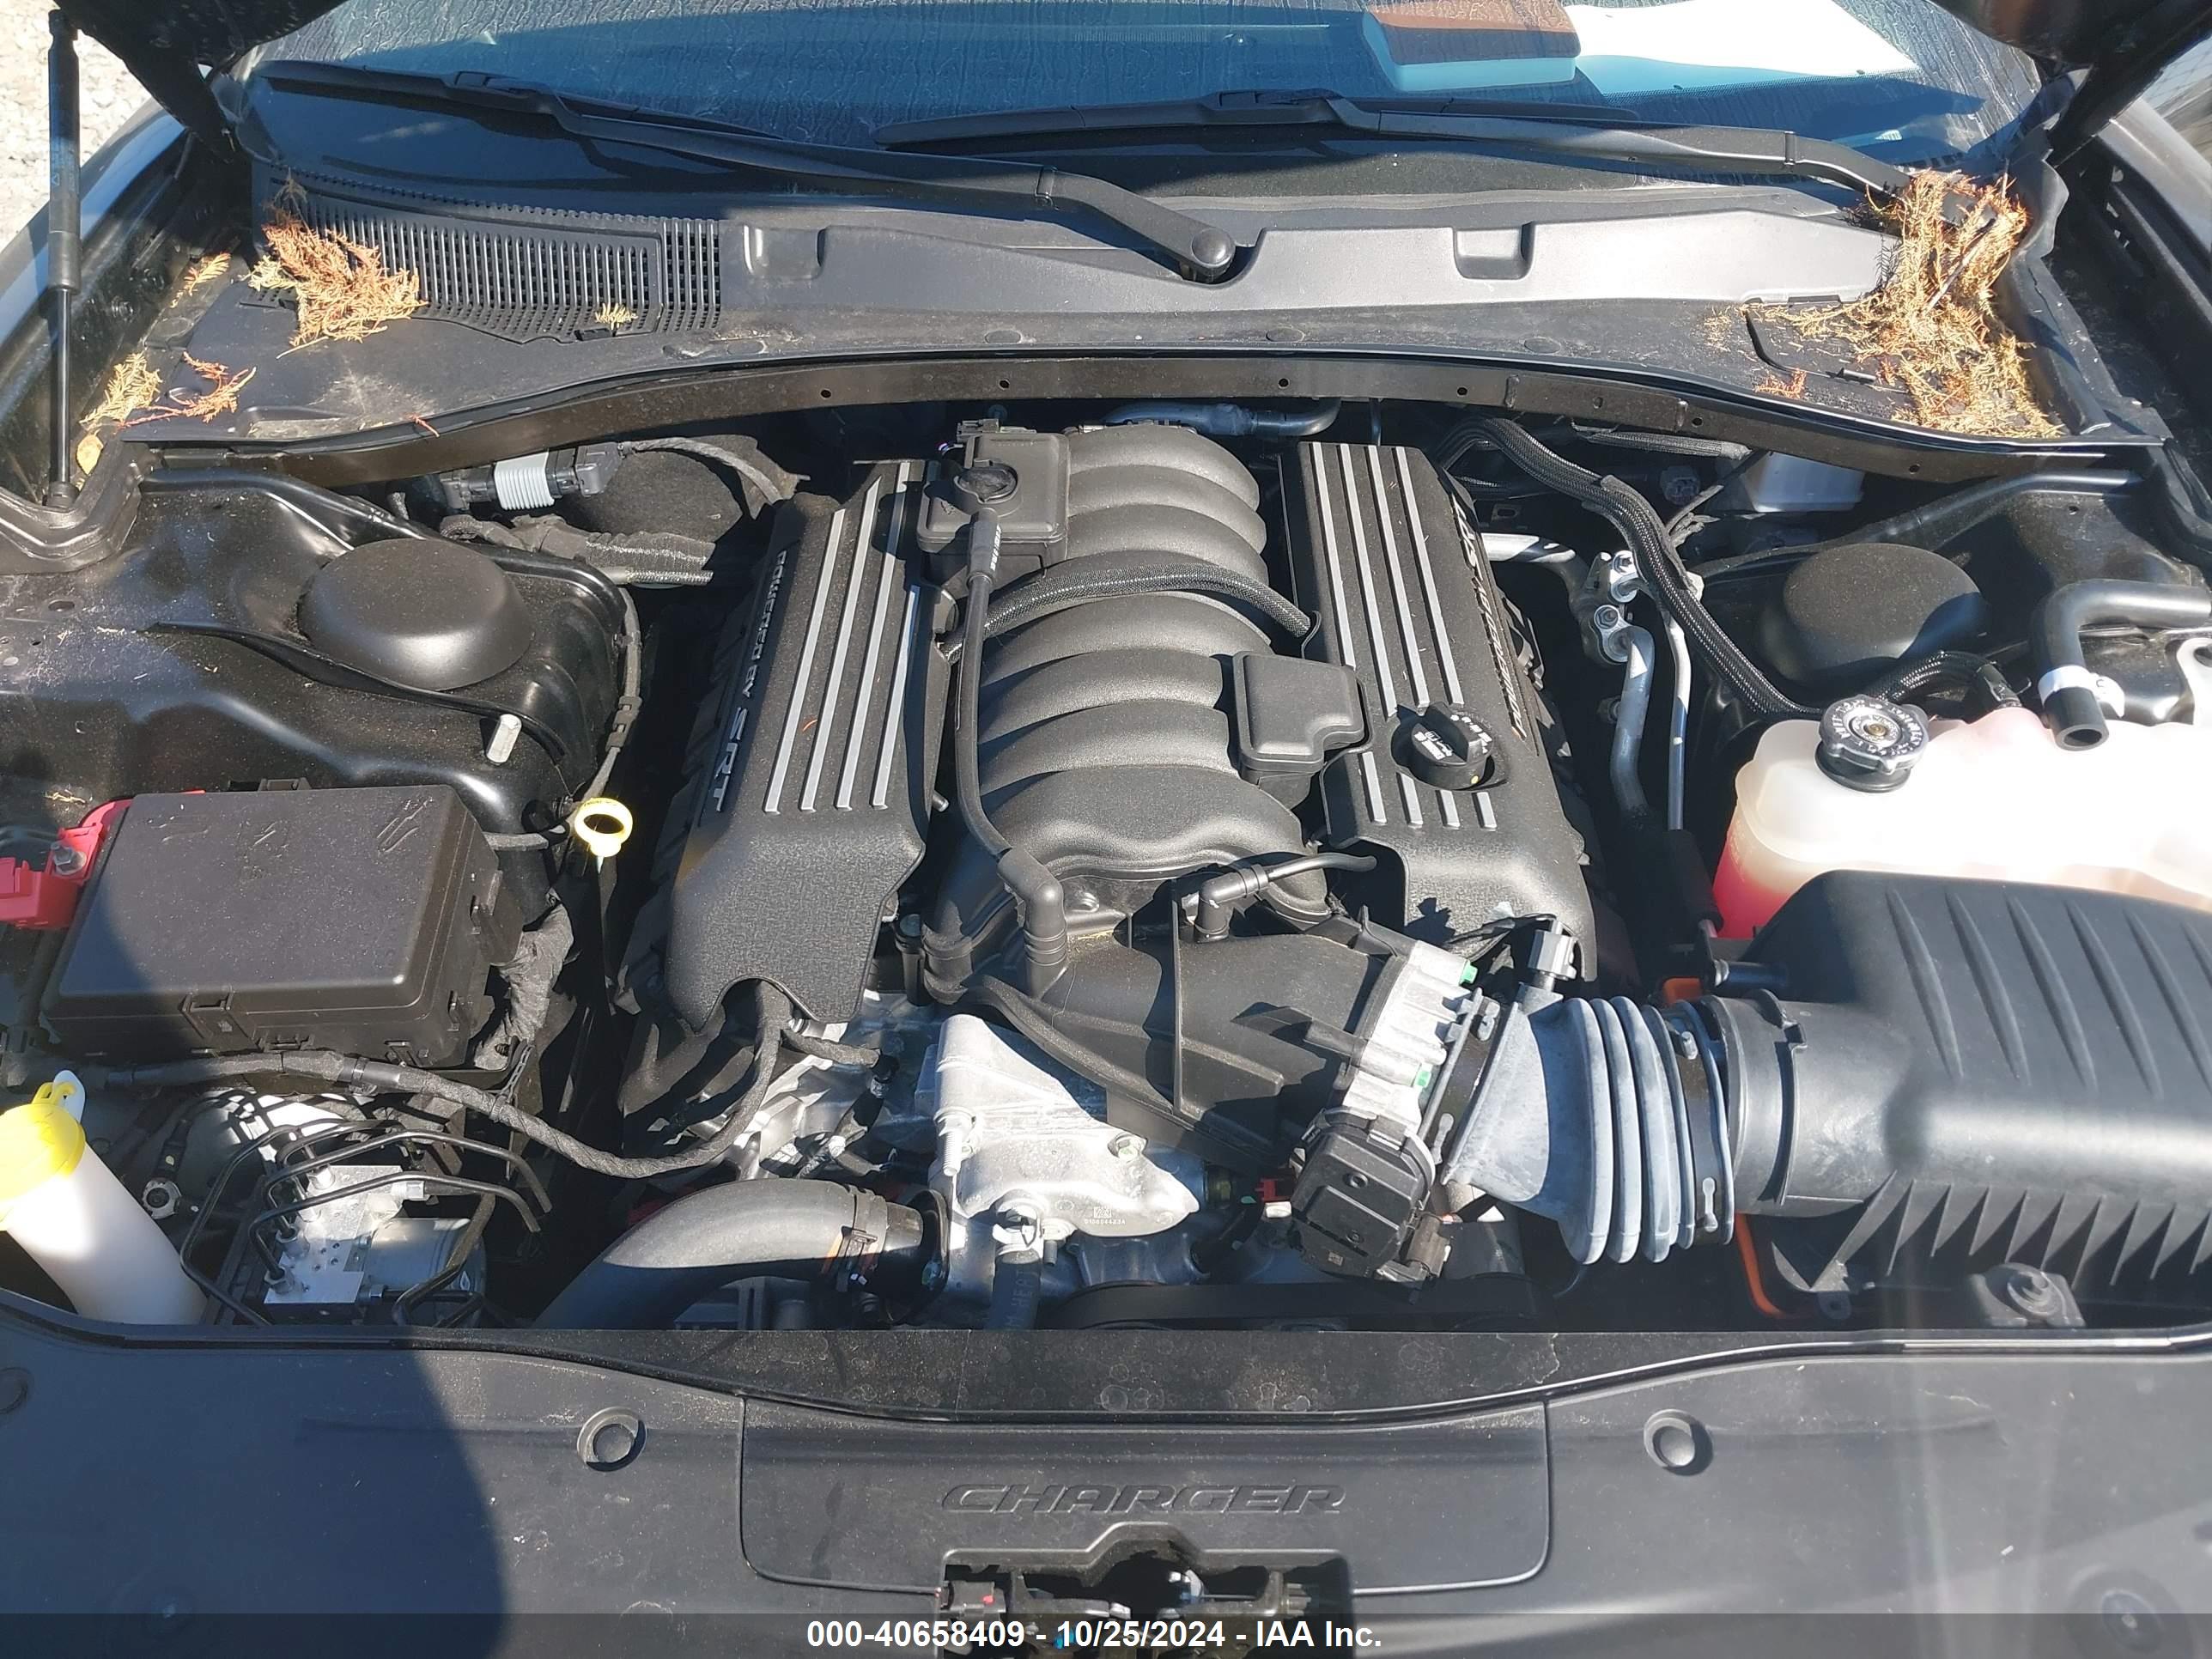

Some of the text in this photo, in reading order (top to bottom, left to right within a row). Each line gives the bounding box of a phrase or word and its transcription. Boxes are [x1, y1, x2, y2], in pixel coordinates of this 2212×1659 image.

[713, 550, 787, 811] POWERED BY SRT
[1451, 494, 1527, 738] POWERED BY SRT
[942, 1484, 1346, 1513] CHARGER
